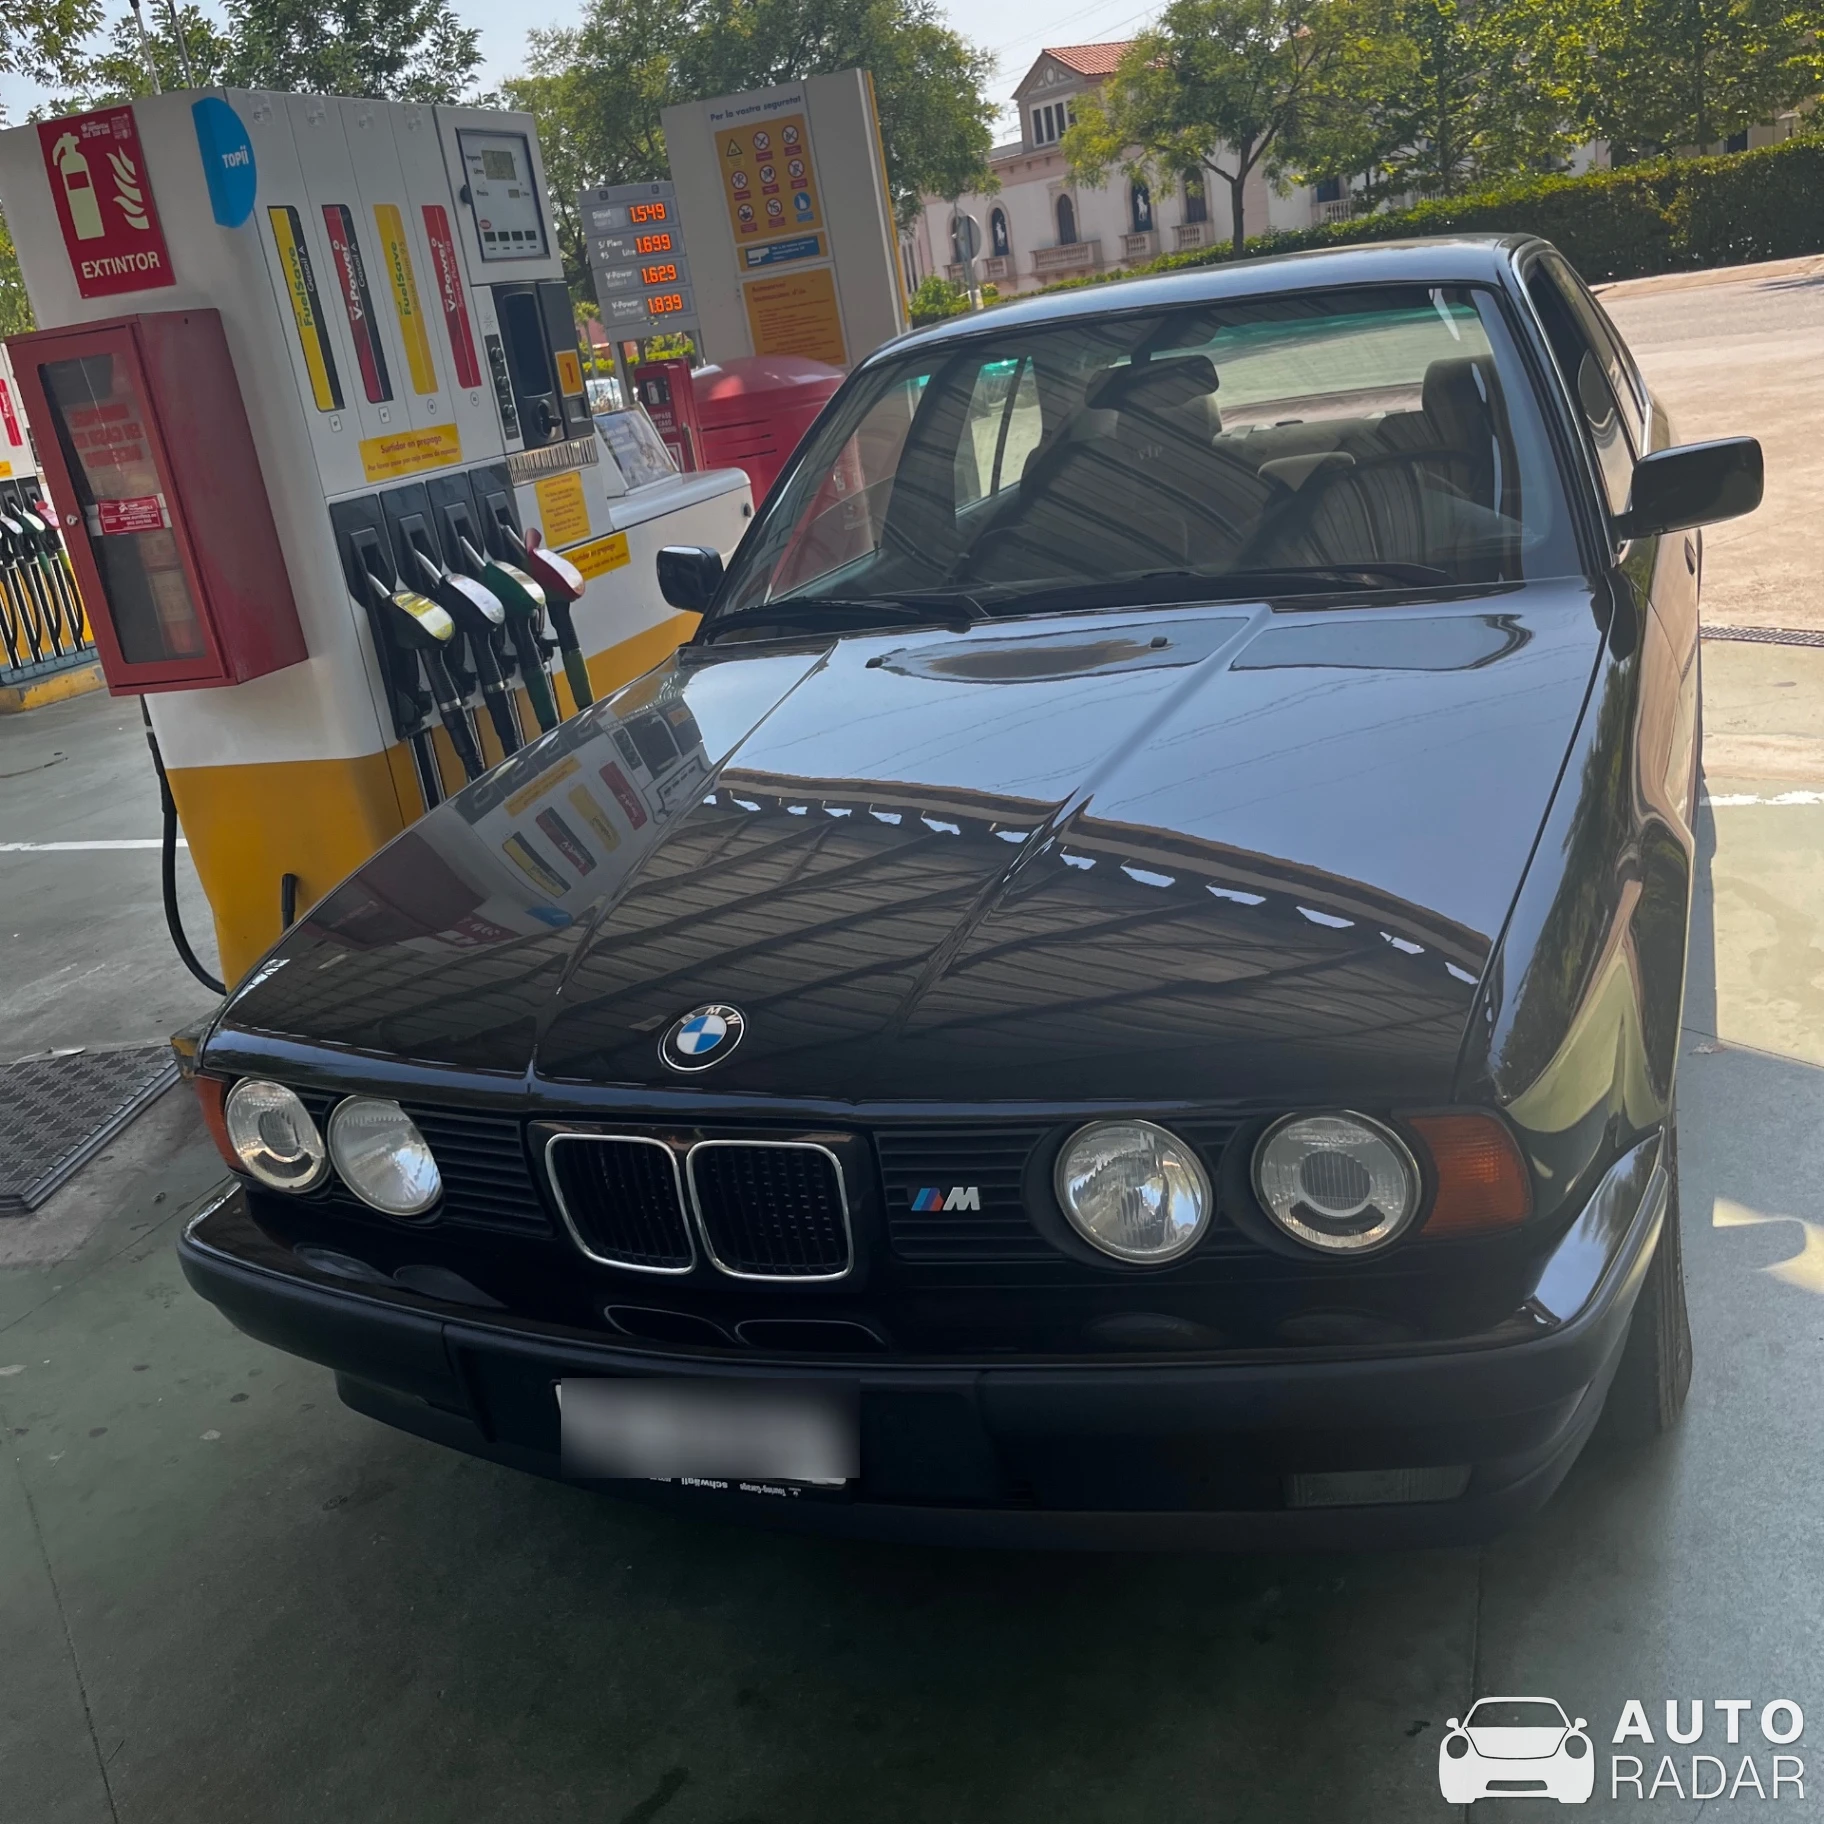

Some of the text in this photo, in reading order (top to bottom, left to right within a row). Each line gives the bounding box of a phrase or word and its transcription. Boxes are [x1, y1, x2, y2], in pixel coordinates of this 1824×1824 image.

[709, 95, 802, 123] Per la vostra seguretat
[81, 251, 161, 280] EXTINTOR
[298, 245, 314, 292] Gasoil A
[350, 243, 366, 288] Gasoil A
[390, 241, 413, 316] FuelSave
[437, 241, 457, 312] V-Power
[605, 271, 633, 281] V-Power
[289, 247, 313, 327] FuelSave
[340, 244, 363, 320] V-Power
[612, 300, 640, 309] V-Power
[565, 362, 575, 384] 1
[381, 442, 406, 454] Surtidor
[680, 1007, 741, 1026] BMW
[942, 1186, 981, 1212] M
